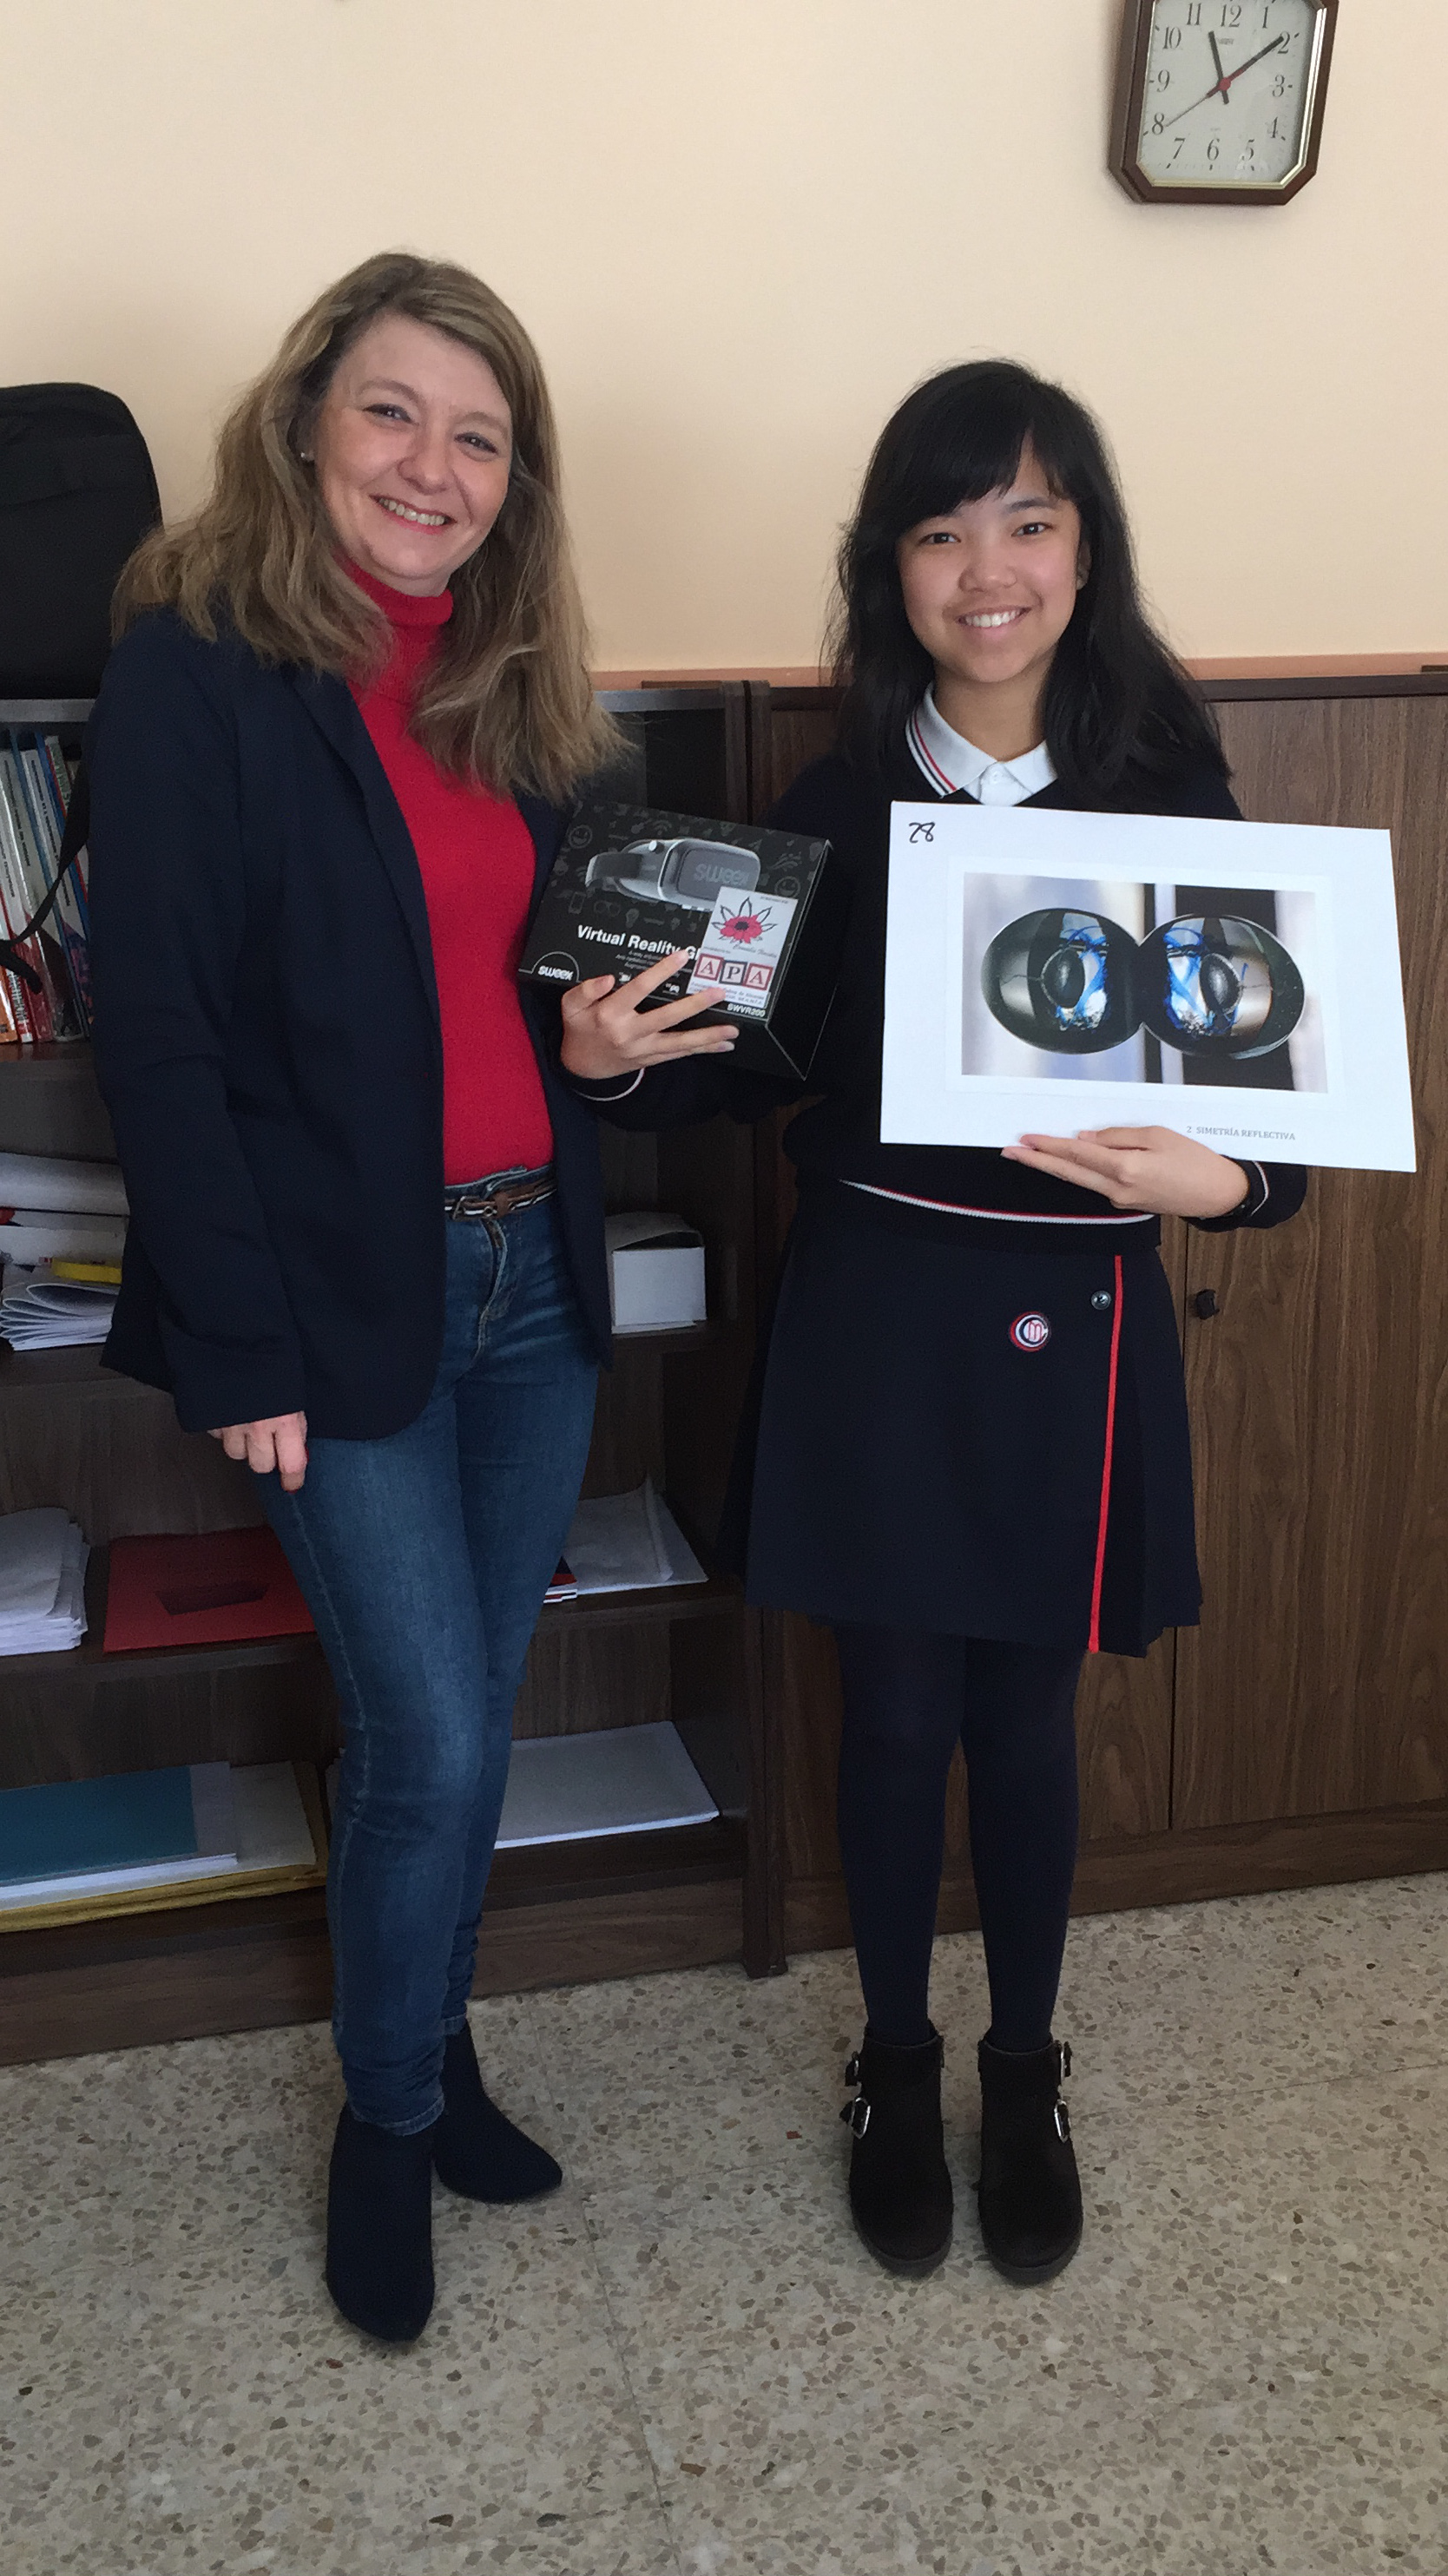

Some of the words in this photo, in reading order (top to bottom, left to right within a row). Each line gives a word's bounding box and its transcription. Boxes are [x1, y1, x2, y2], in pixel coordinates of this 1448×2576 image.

[1186, 3, 1202, 26] 11
[1220, 4, 1242, 28] 12
[1261, 6, 1270, 29] 1
[1162, 27, 1181, 49] 10
[1277, 30, 1291, 55] 2
[1157, 69, 1170, 93] 9
[1272, 74, 1286, 98] 3
[1151, 112, 1165, 135] 8
[1173, 137, 1186, 160] 7
[1207, 138, 1220, 161] 6
[1241, 138, 1255, 161] 5
[577, 924, 626, 947] Virtual
[1196, 1126, 1240, 1137] SIMETRÍA
[1241, 1129, 1296, 1140] REFLECTIVA
